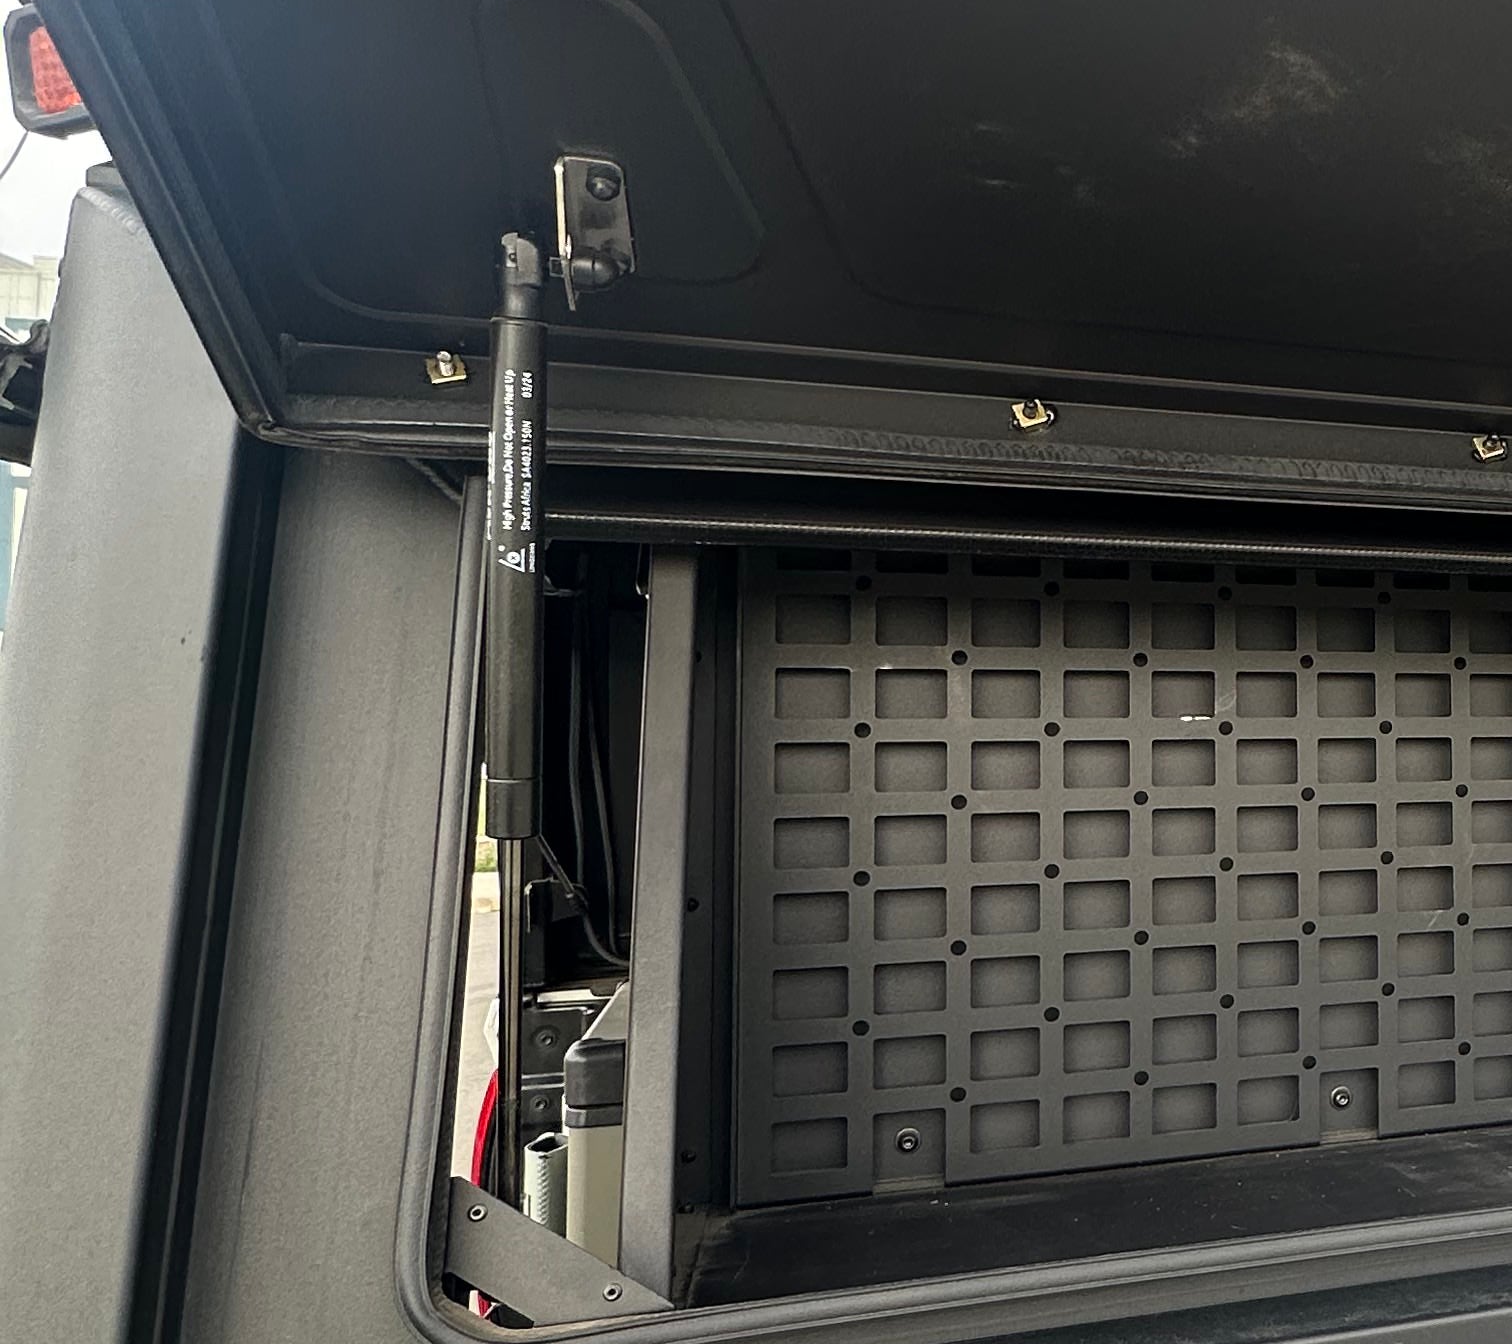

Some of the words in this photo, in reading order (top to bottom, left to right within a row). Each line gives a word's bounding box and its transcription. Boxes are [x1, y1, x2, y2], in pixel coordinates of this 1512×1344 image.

[503, 369, 516, 384] Up
[521, 371, 533, 399] 03/24
[504, 405, 514, 416] or
[502, 416, 516, 441] Open
[503, 441, 514, 458] Not
[520, 481, 532, 506] Africa
[502, 509, 516, 531] High
